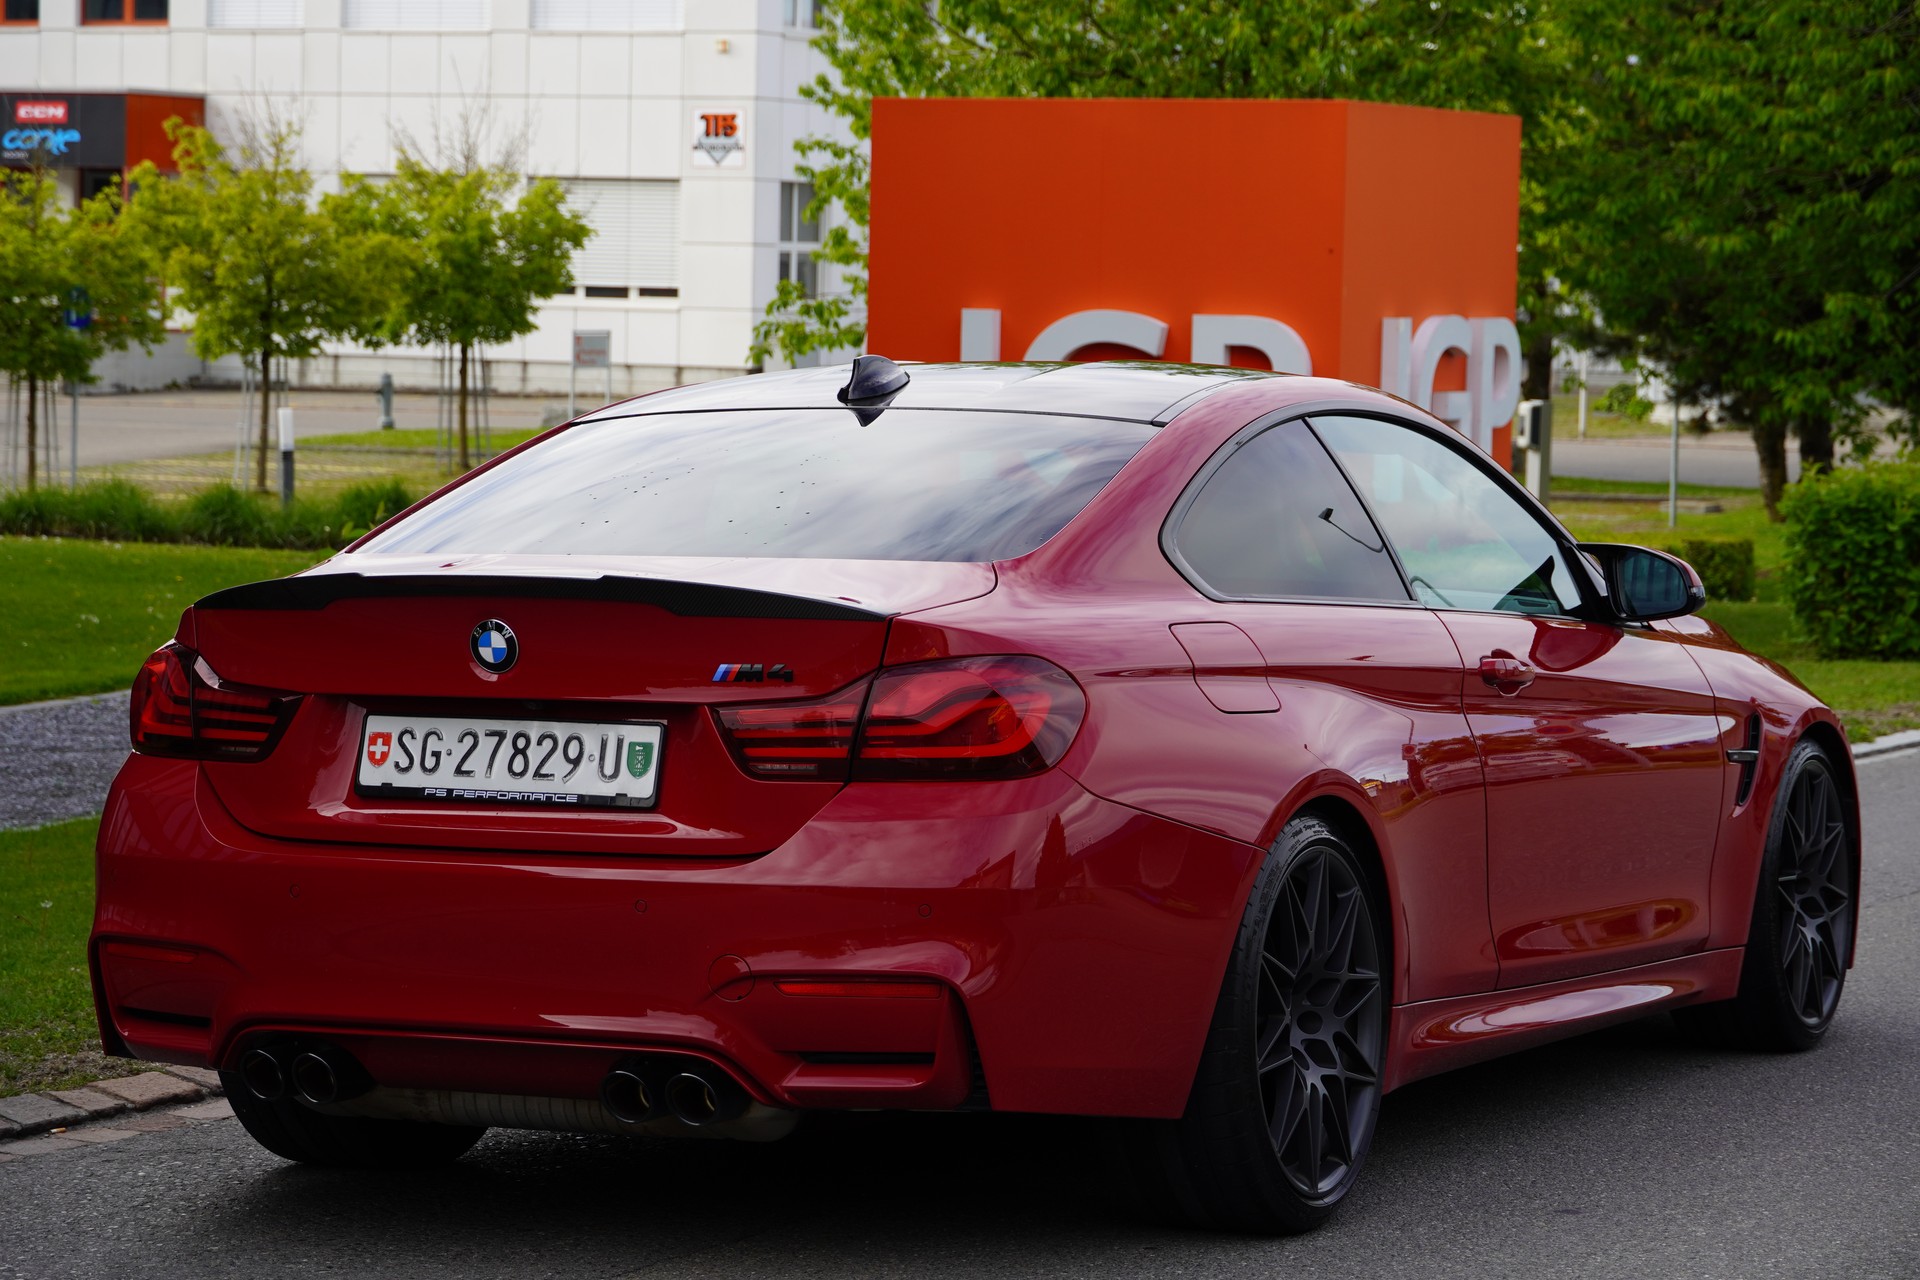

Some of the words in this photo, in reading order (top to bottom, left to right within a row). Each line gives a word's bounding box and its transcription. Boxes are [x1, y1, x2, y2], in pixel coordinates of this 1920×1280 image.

[474, 620, 512, 639] BMW
[733, 663, 793, 682] M4
[424, 787, 448, 798] PS
[453, 788, 578, 803] PERFORMANCE
